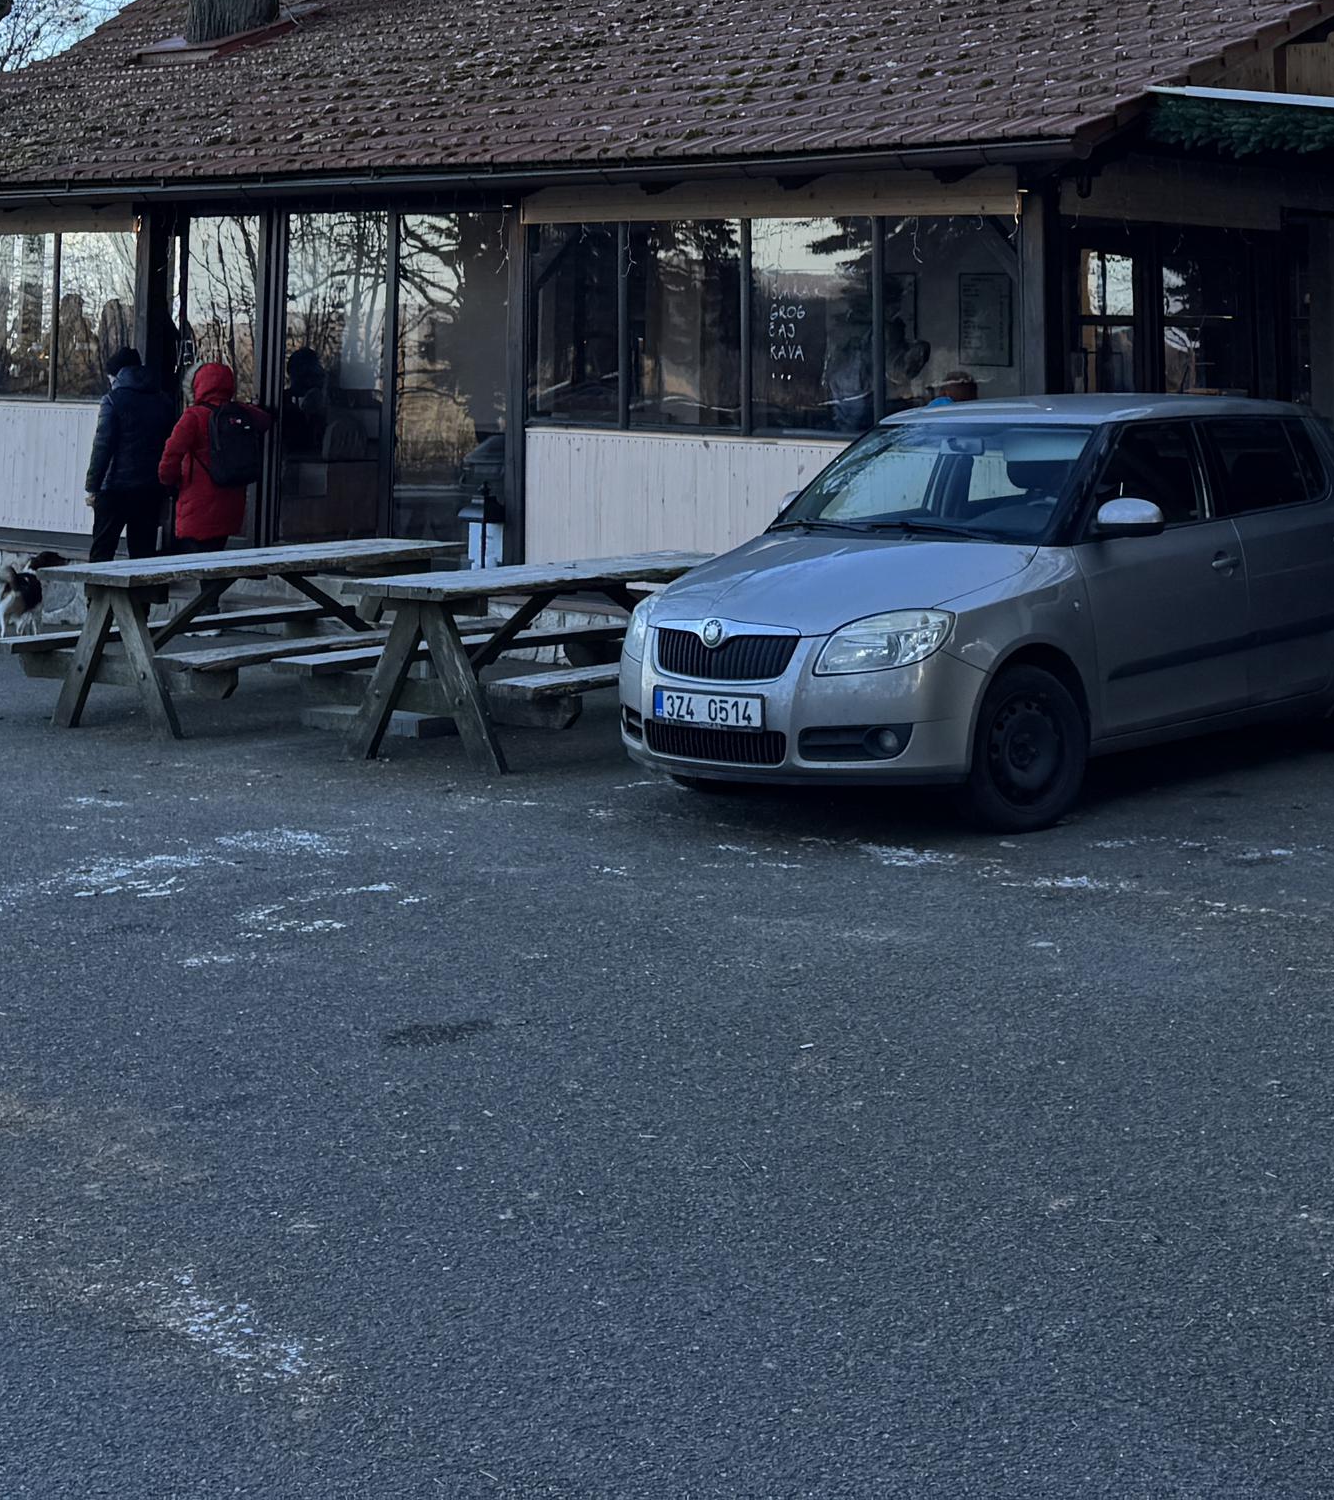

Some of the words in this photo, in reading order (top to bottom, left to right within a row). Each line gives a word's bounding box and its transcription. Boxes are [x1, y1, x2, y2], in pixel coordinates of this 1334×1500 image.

[770, 304, 806, 320] GROG
[667, 694, 695, 720] 3Z4
[708, 698, 752, 725] 0514
